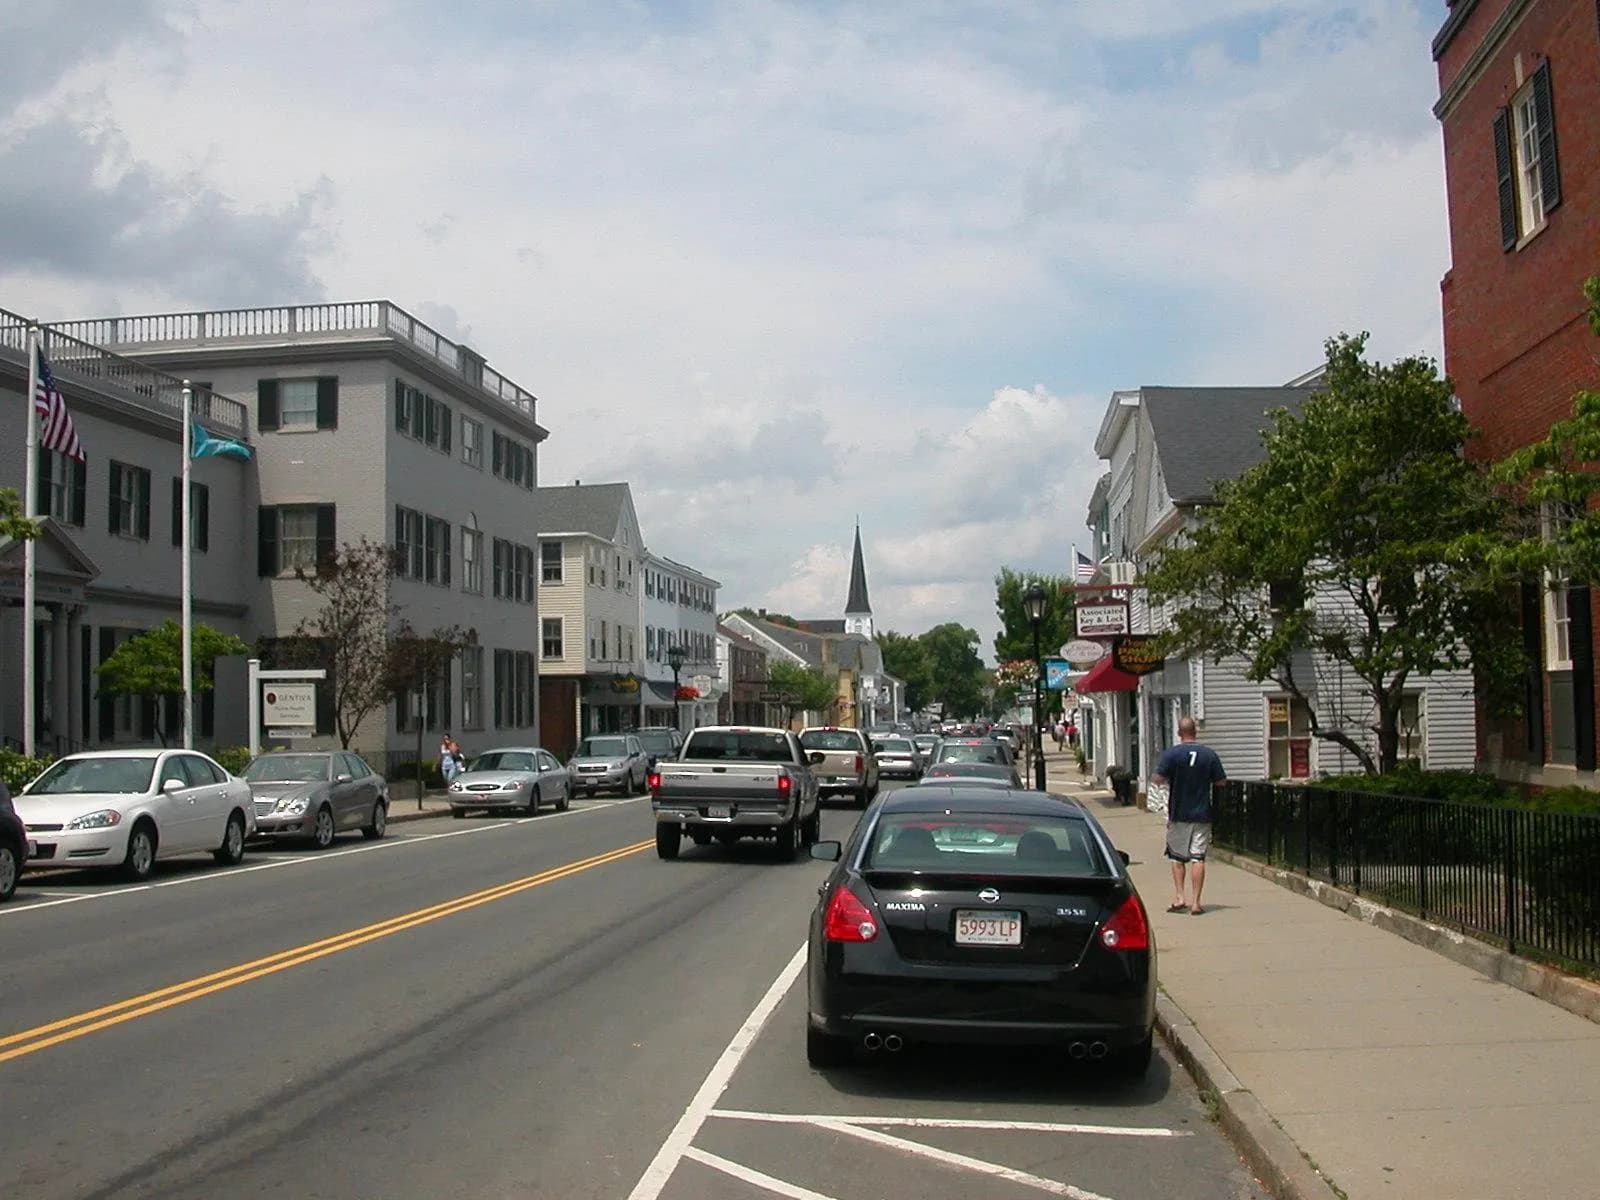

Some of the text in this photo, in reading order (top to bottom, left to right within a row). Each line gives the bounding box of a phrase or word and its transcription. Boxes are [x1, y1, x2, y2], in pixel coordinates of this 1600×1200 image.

[1080, 606, 1124, 616] Associated
[1080, 617, 1094, 625] Key
[1106, 614, 1124, 622] Lock
[279, 694, 312, 702] GENTIVA
[1189, 751, 1198, 767] 7
[886, 902, 926, 911] MAXIMA
[959, 919, 1018, 936] 5993 LP
